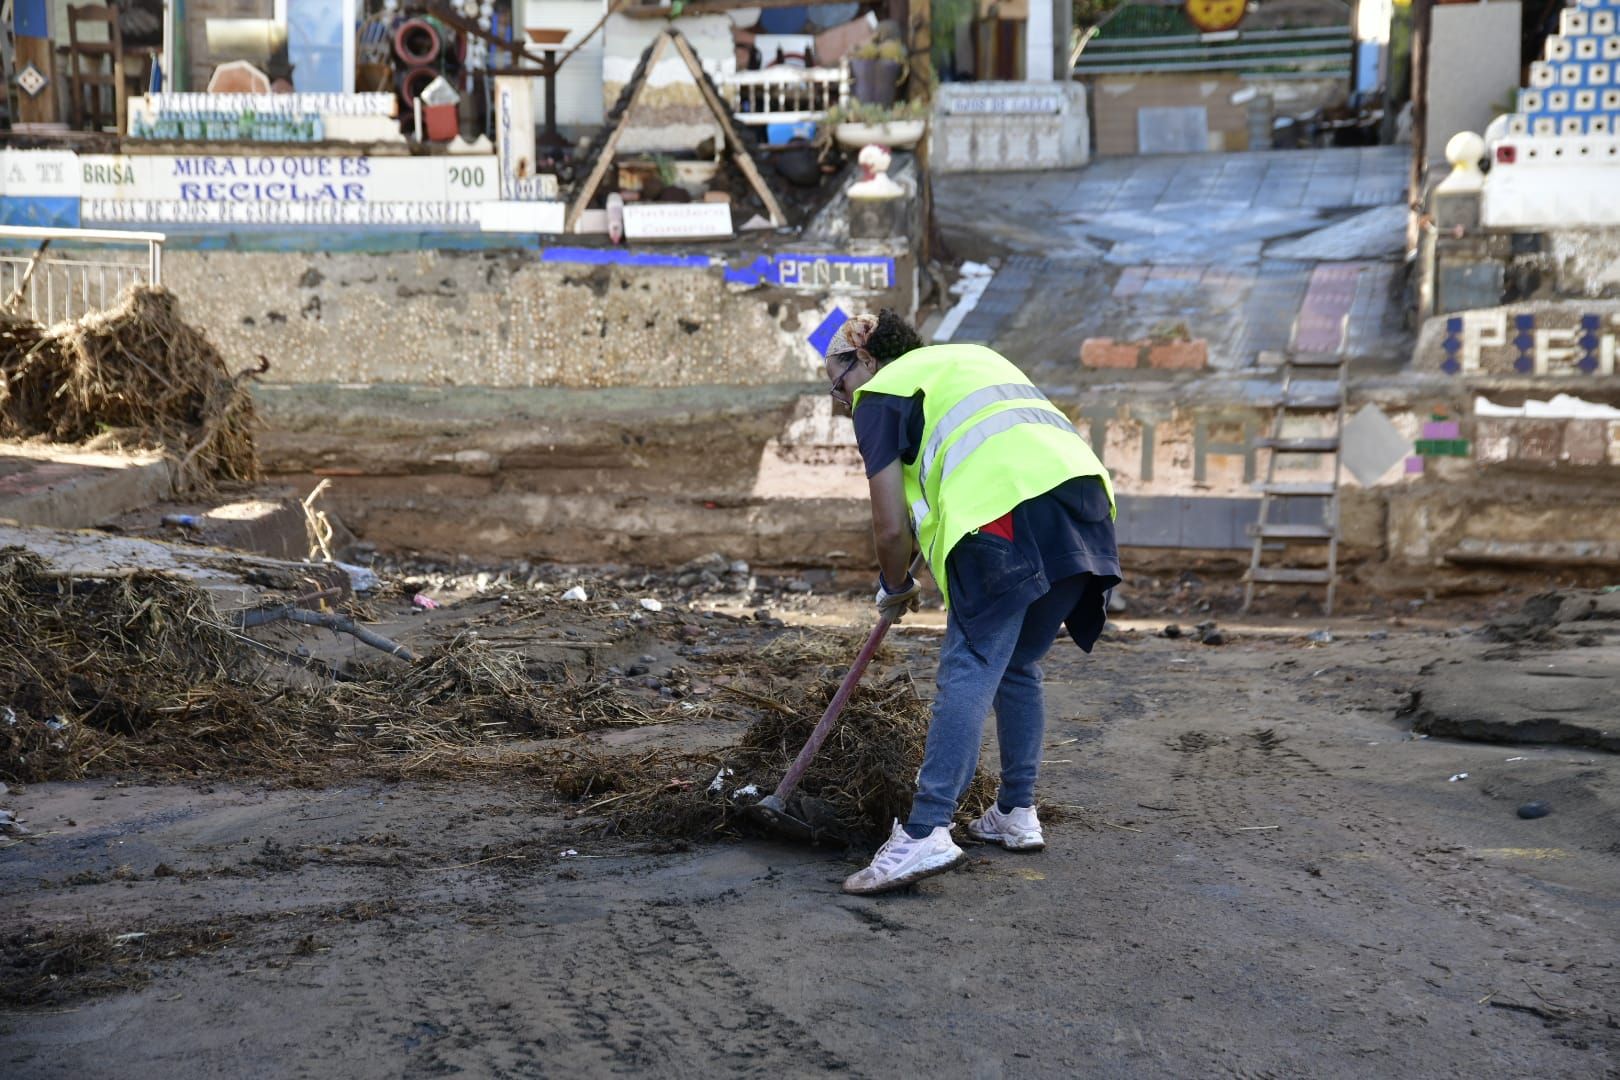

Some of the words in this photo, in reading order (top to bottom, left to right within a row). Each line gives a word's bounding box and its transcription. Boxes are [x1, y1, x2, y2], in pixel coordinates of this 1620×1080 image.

[82, 163, 135, 184] BRISA
[172, 156, 236, 176] MIRA
[244, 157, 275, 176] LO
[282, 157, 332, 179] QUE
[339, 156, 371, 176] ES
[449, 166, 484, 187] 200
[179, 182, 367, 201] RECICLAR
[92, 199, 136, 218] PLAYA
[146, 199, 162, 219] DE
[173, 199, 208, 219] OJOS
[218, 200, 234, 220] DE
[779, 258, 889, 288] PEÑITA
